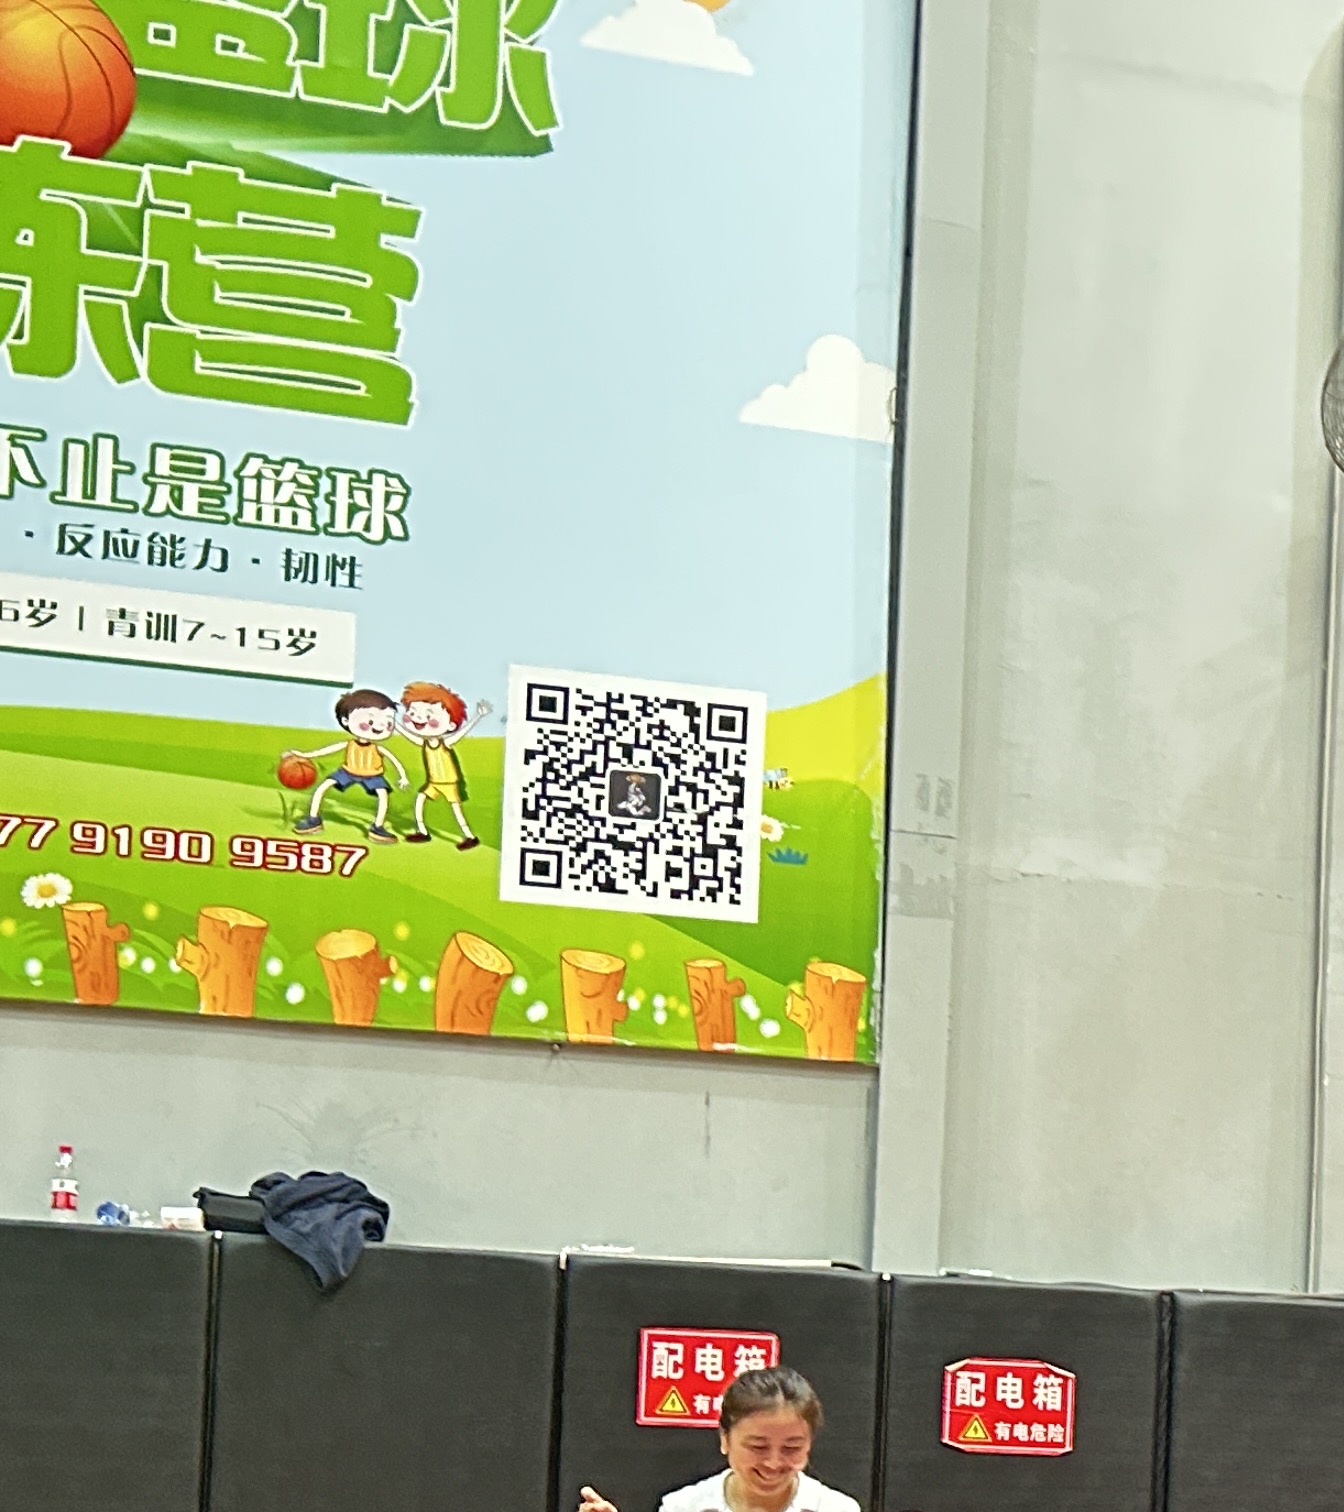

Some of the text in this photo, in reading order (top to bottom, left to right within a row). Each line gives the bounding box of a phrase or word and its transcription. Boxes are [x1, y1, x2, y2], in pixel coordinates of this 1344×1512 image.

[69, 820, 215, 865] 9190
[229, 834, 370, 877] 9587
[955, 1370, 1064, 1411] 配电箱
[995, 1421, 1065, 1443] 有电危险
